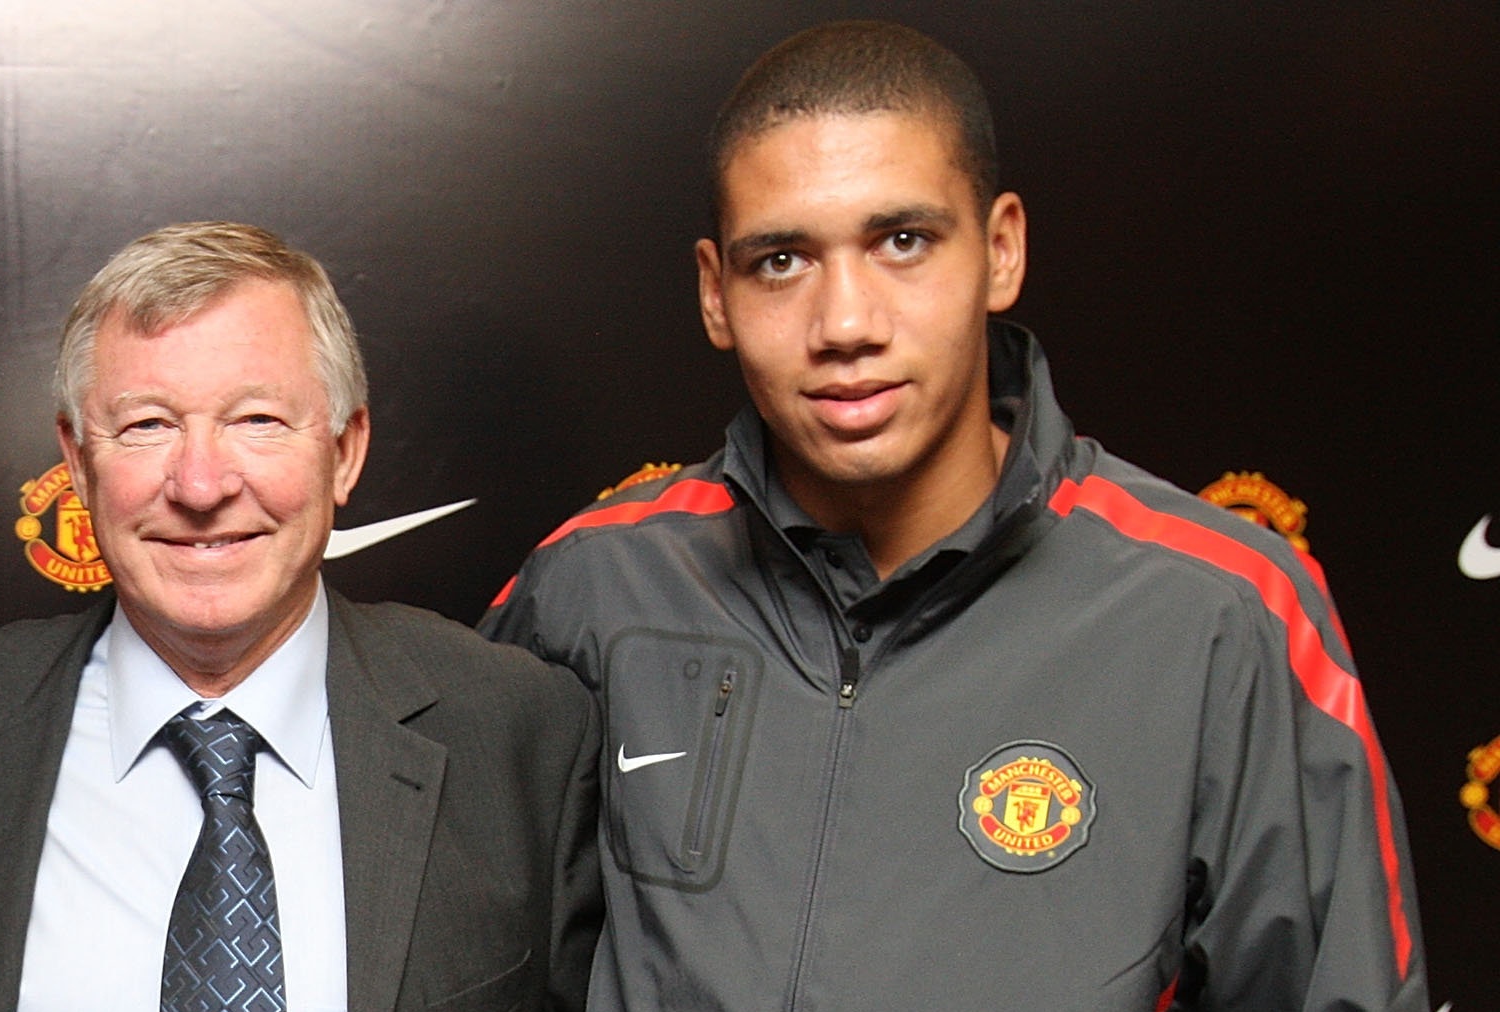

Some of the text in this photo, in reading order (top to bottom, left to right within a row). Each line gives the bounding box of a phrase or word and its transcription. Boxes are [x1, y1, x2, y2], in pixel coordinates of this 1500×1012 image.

[46, 558, 109, 580] UNITE
[987, 764, 1073, 800] MANCHESTER
[993, 828, 1053, 848] UNITED
